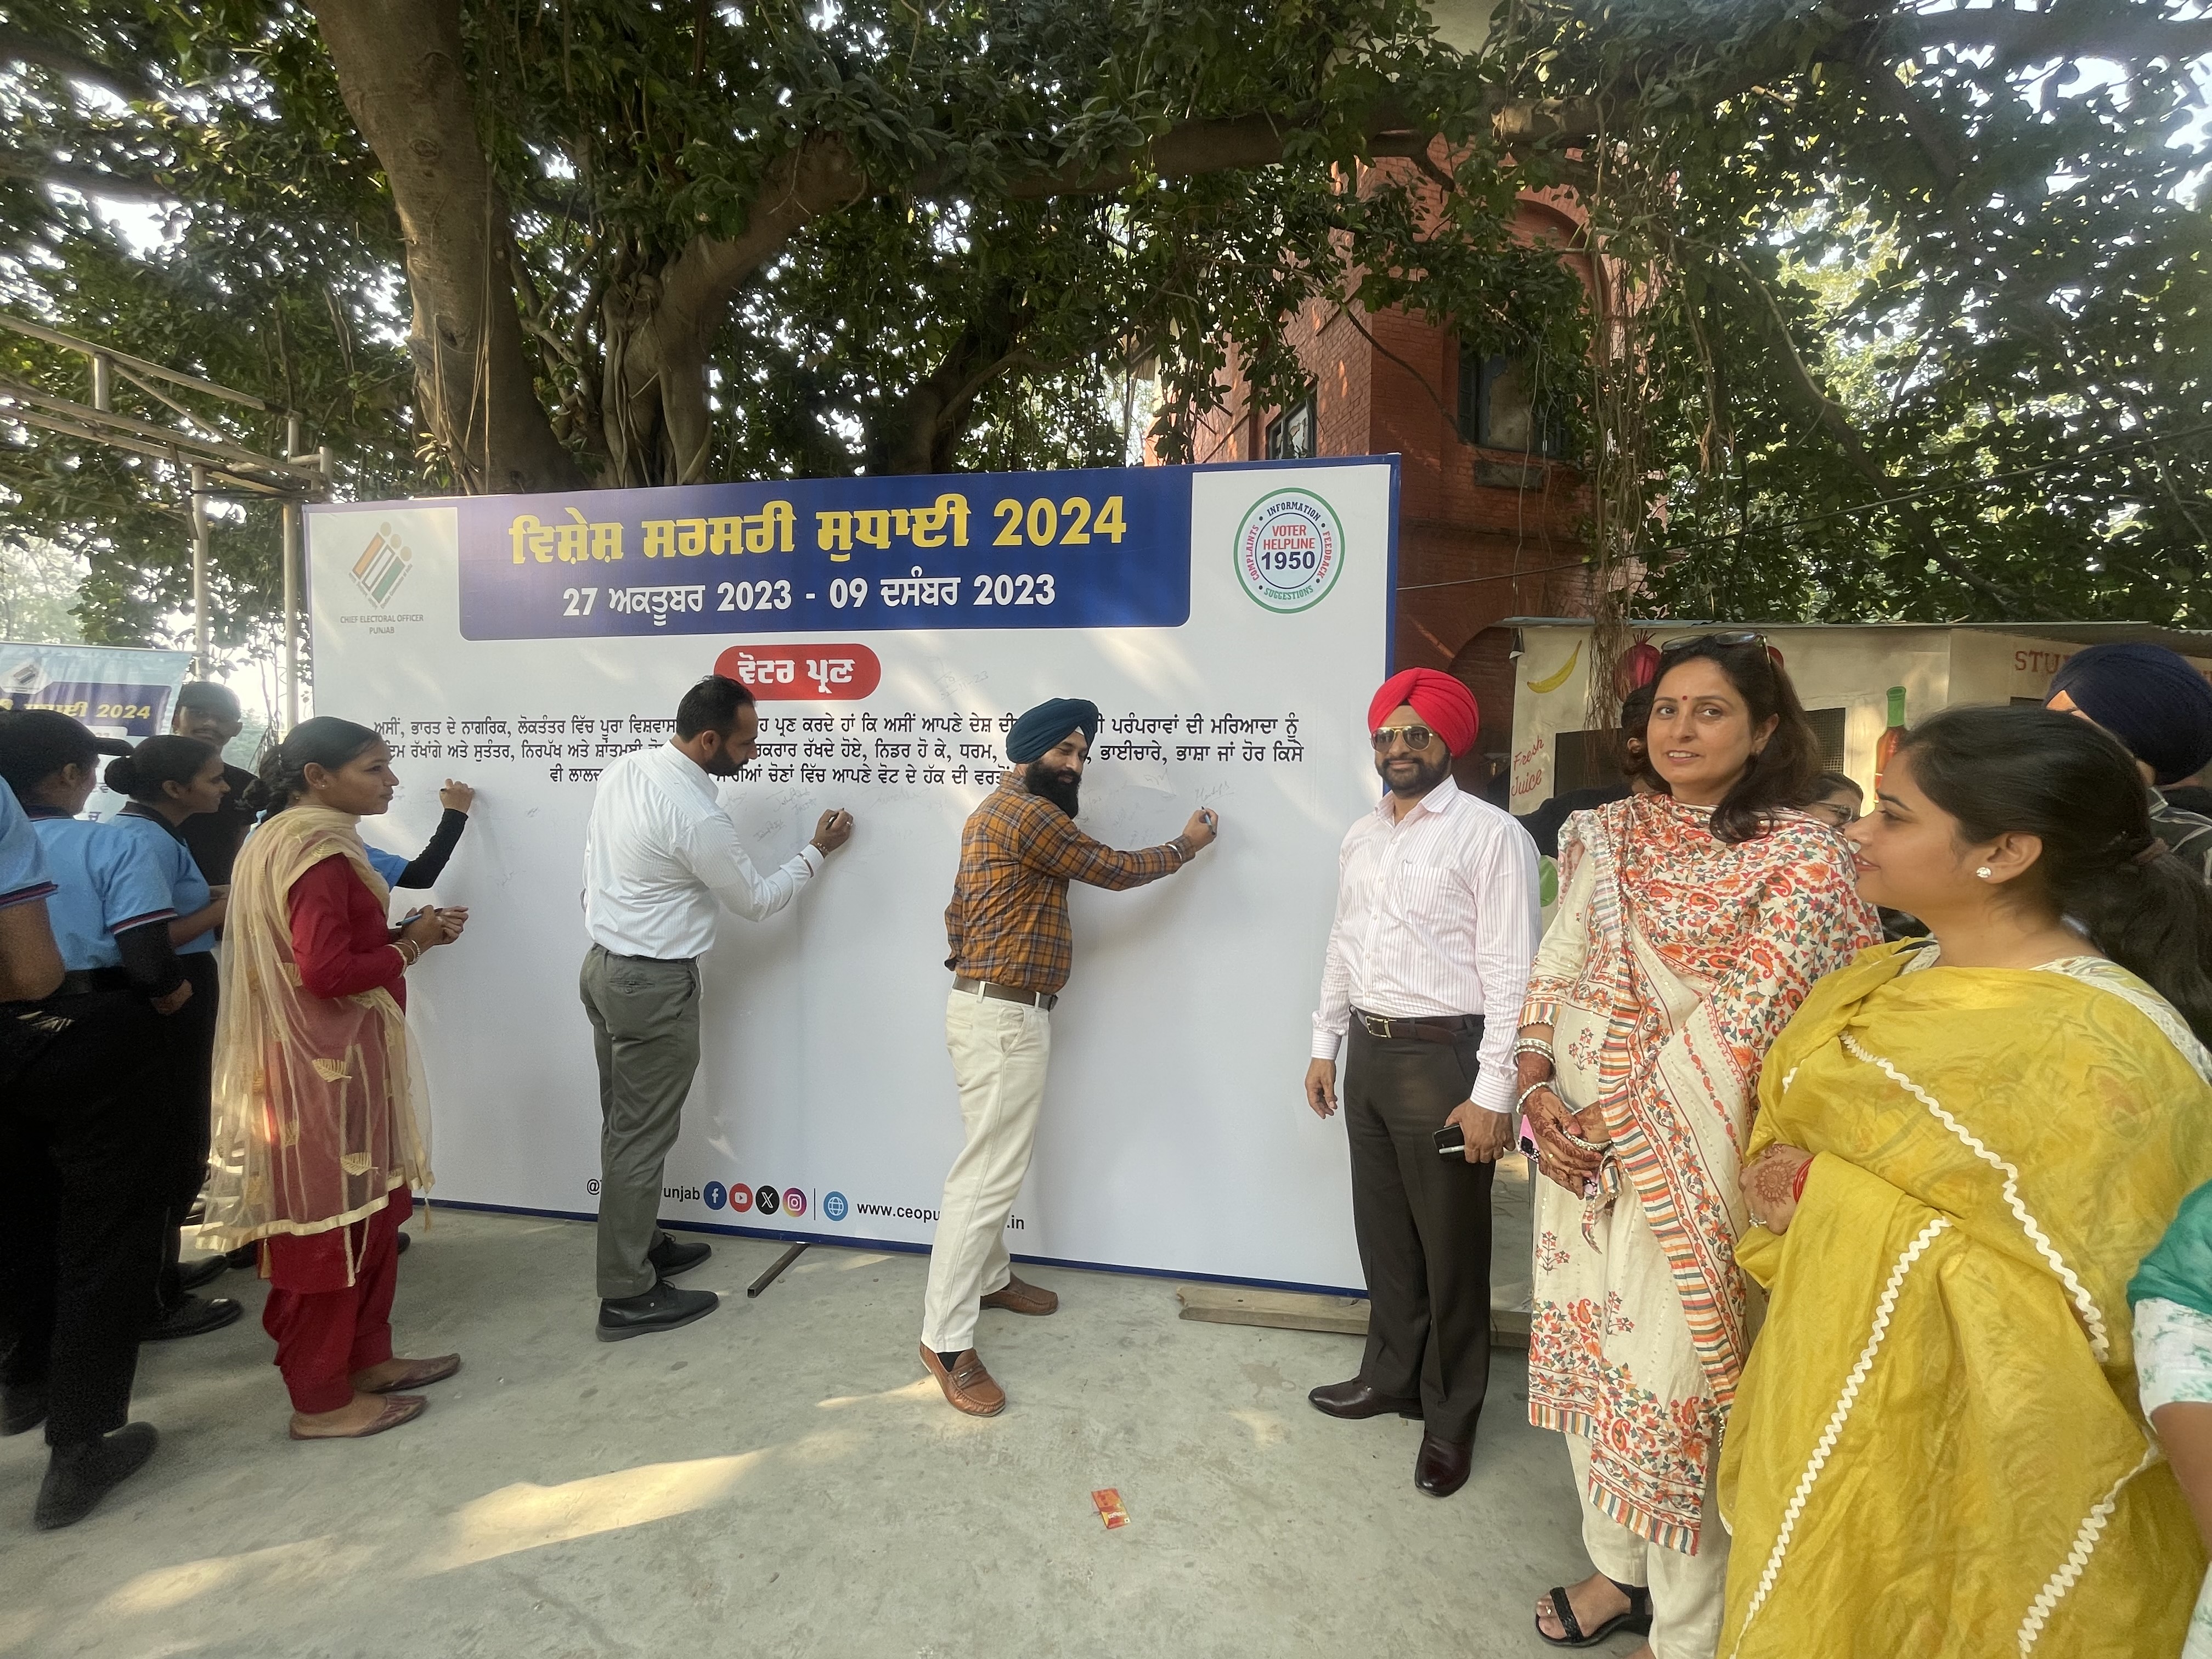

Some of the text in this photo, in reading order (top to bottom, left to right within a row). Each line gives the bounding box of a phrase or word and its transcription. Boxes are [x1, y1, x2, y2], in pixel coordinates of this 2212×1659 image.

[1267, 501, 1321, 521] INFORMATION
[509, 493, 1126, 564] ਵਿਸ਼ੇਸ਼ ਸਰਸਰੀ ਸੁਧਾਈ 2024
[1272, 524, 1307, 537] VOTER
[1246, 524, 1260, 581] COMPLAINTS
[1263, 538, 1316, 550] HELPLINE
[1317, 531, 1332, 579] FEEDBACK
[1261, 551, 1315, 570] 1950
[563, 587, 598, 616] 27
[608, 584, 706, 627] ਅਕਤੂਬਰ
[716, 580, 792, 612] 2023
[830, 578, 868, 608] 09
[880, 566, 961, 607] ਦਸੰਬਰ
[973, 574, 1056, 606] 2023
[1264, 585, 1313, 600] SUGGESTIONS
[360, 614, 396, 623] ELECTORAL
[397, 614, 424, 622] OFFICER
[369, 626, 395, 634] PUNJAB
[737, 652, 856, 693] ਵੋਟਰ ਪ੍ਰਣ
[2015, 650, 2070, 674] STU
[96, 704, 151, 719] 2024
[374, 716, 405, 738] ਅਸੀਂ,
[411, 721, 441, 735] ਭਾਰਤ
[447, 716, 456, 735] ਦੇ
[461, 715, 511, 738] ਨਾਗਰਿਕ,
[517, 714, 566, 734] ਲੋਕਤੰਤਰ
[571, 714, 595, 734] ਵਿੱਚ
[601, 719, 623, 741] ਪੂਰਾ
[775, 718, 797, 737] ਪ੍ਰਣ
[803, 712, 834, 732] ਕਰਦੇ
[840, 713, 855, 732] ਹਾਂ
[861, 712, 878, 732] ਕਿ
[884, 712, 916, 732] ਅਸੀਂ
[922, 712, 963, 732] ਆਪਣੇ
[969, 712, 992, 732] ਦੇਸ਼
[1111, 712, 1180, 734] ਪਰੰਪਰਾਵਾਂ
[1186, 713, 1204, 734] ਦੀ
[1211, 713, 1278, 735] ਮਰਿਆਦਾ
[1285, 712, 1299, 741] ਨੂੰ
[411, 740, 442, 758] ਰੱਖਾਂਗੇ
[448, 739, 469, 758] ਅਤੇ
[473, 740, 515, 762] ਸੁਤੰਤਰ,
[521, 739, 562, 758] ਨਿਰਪੱਖ
[568, 739, 590, 758] ਅਤੇ
[757, 743, 797, 757] ਰਕਰਾਰ
[804, 737, 834, 757] ਰੱਖਦੇ
[840, 737, 867, 761] ਹੋਏ,
[875, 738, 911, 758] ਨਿਡਰ
[917, 737, 928, 758] ਹੋ
[934, 738, 951, 763] ਕੇ,
[960, 744, 997, 763] ਧਰਮ,
[1100, 739, 1304, 765] ਭਾਈਚਾਰੇ, ਭਾਸ਼ਾ ਜਾਂ ਹੋਰ ਕਿਸੇ
[1514, 735, 1544, 771] Fresh
[550, 763, 563, 782] ਵੀ
[768, 761, 795, 782] ਚੋਣਾਂ
[800, 763, 826, 783] ਵਿੱਚ
[832, 763, 872, 783] ਆਪਣੇ
[878, 763, 899, 783] ਵੋਟ
[905, 763, 917, 784] ਦੇ
[923, 764, 945, 785] ਹੱਕ
[952, 764, 968, 785] ਦੀ
[1511, 769, 1542, 796] Juice
